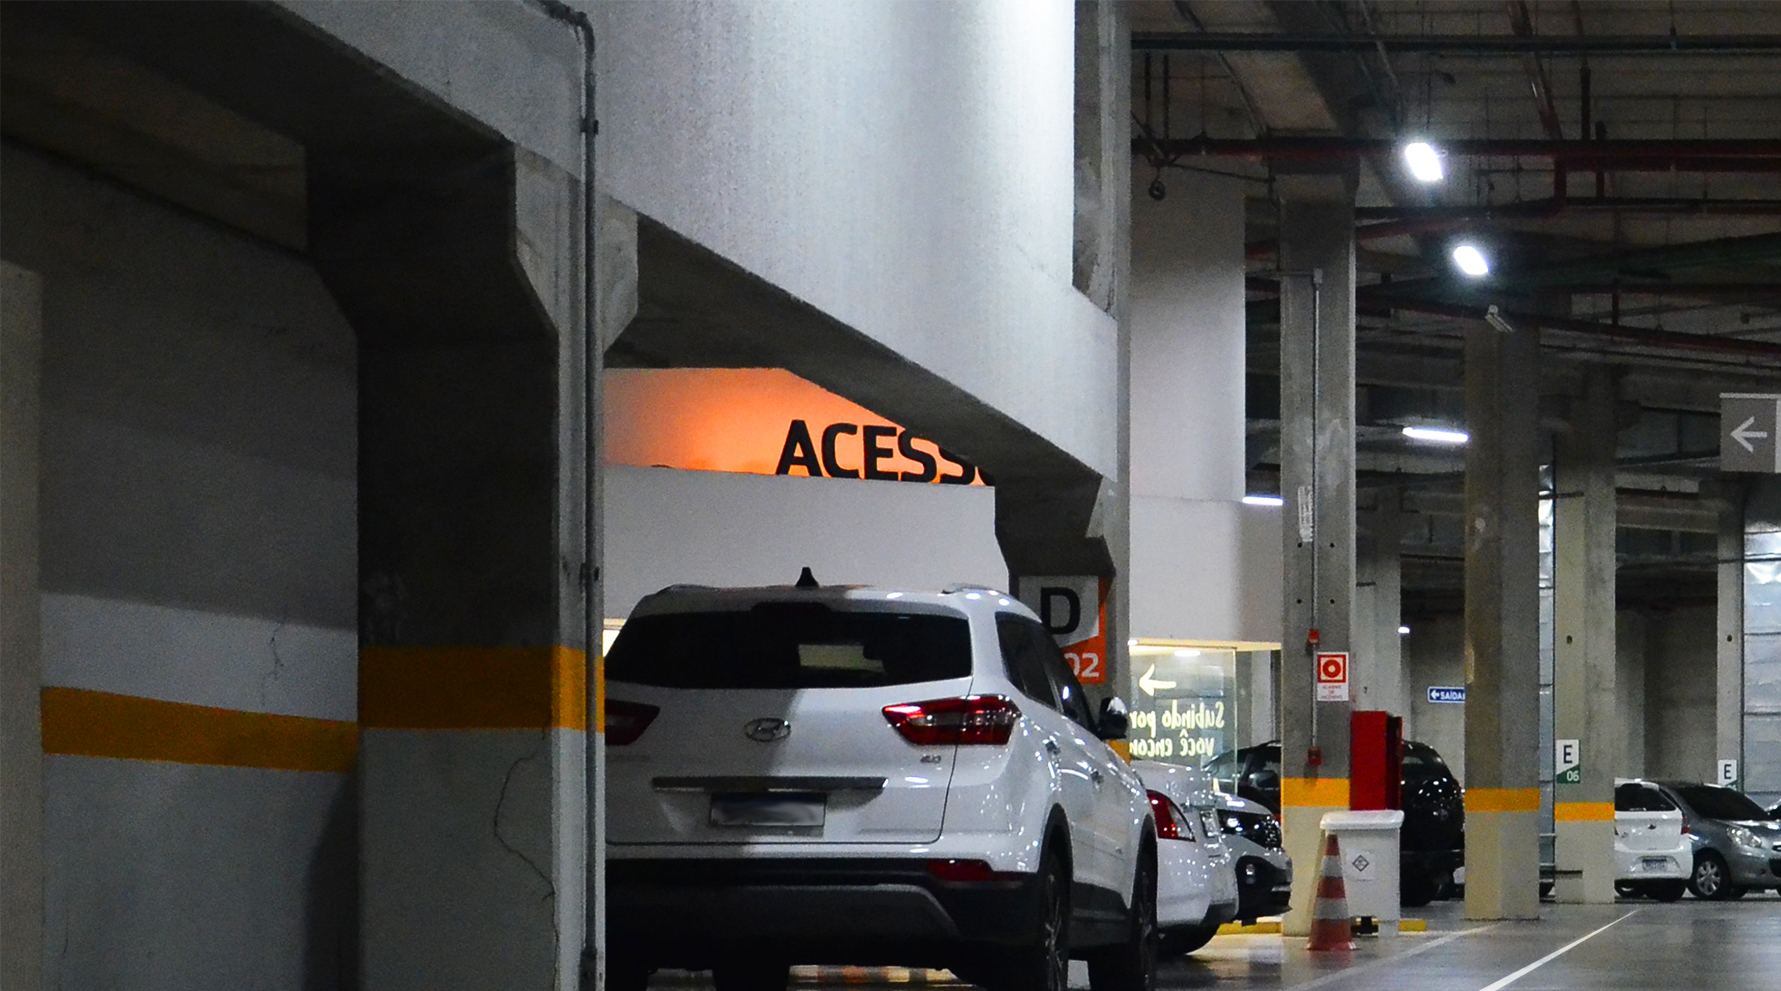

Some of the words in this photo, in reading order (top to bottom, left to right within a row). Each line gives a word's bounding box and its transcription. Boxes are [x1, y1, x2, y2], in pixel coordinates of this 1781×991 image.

[775, 419, 995, 485] ACESS
[1041, 587, 1080, 635] D
[1564, 745, 1573, 764] E
[1567, 770, 1580, 781] 06
[1724, 764, 1732, 780] E
